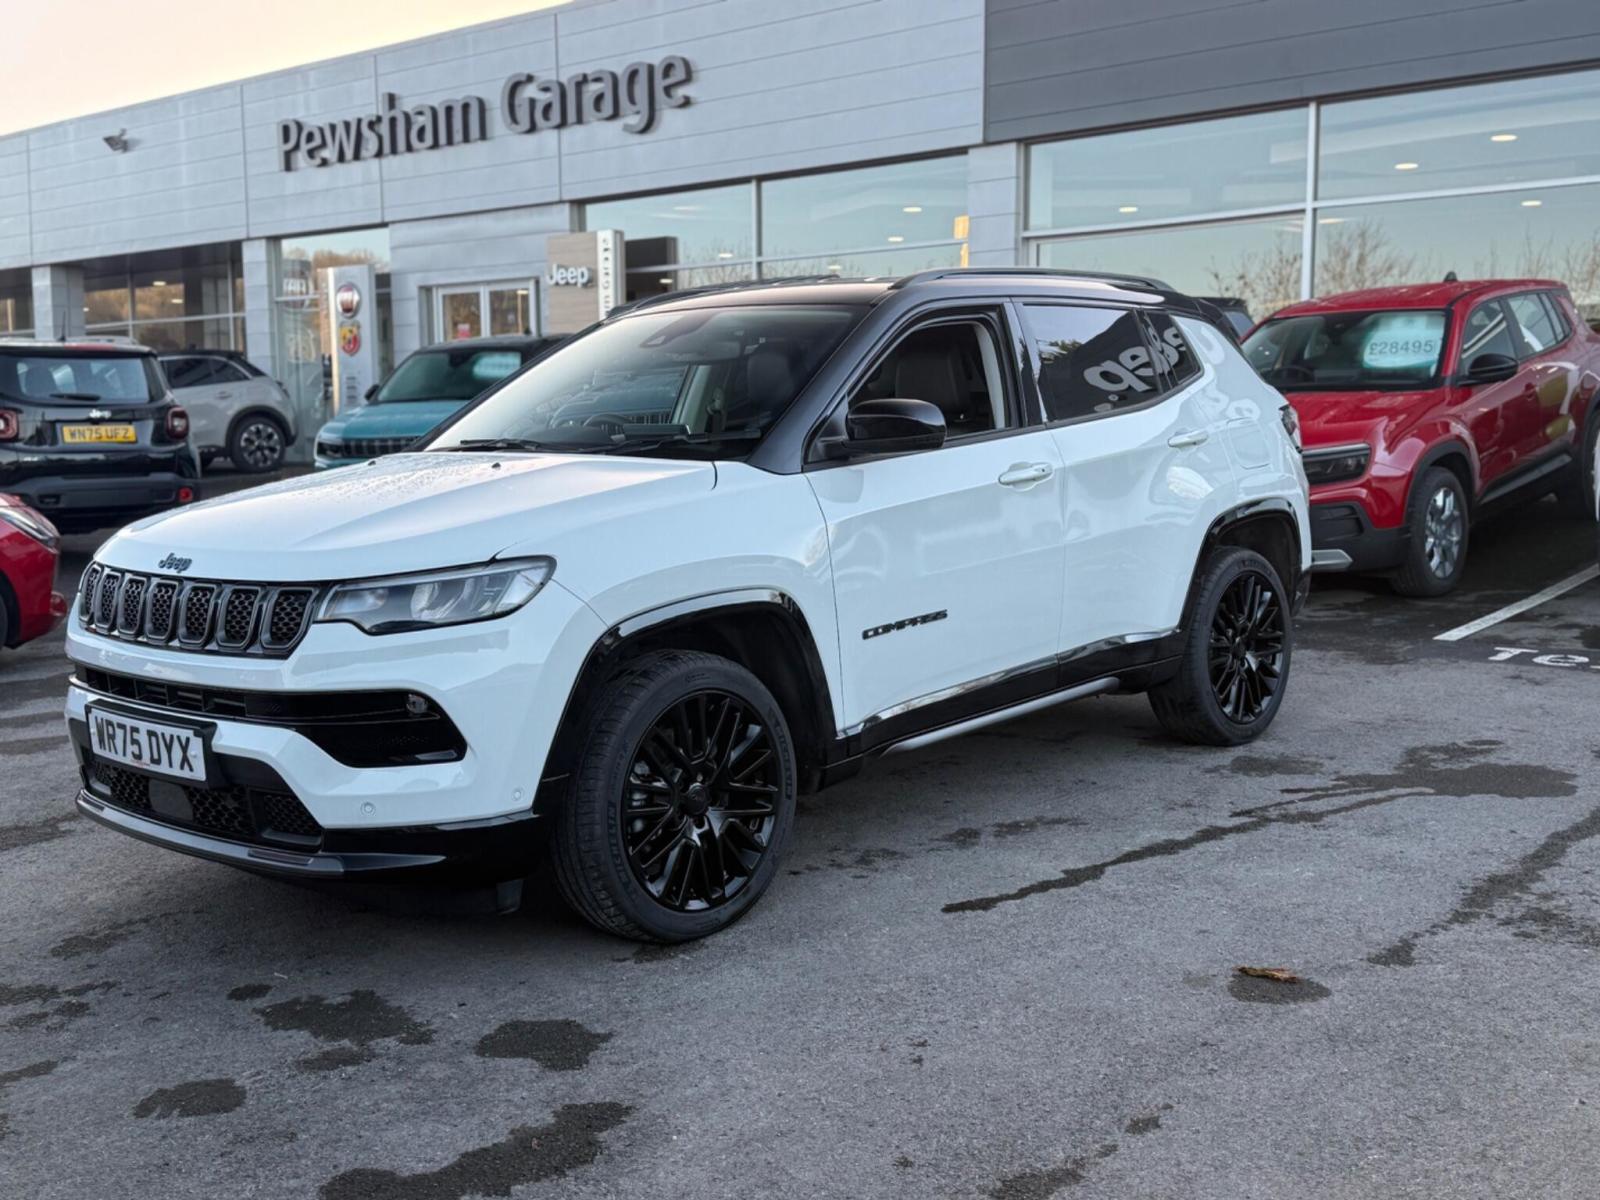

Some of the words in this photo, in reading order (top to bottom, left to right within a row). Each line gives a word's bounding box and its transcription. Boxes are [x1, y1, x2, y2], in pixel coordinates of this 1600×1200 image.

[276, 91, 491, 172] Pewsham
[501, 55, 693, 135] Garage
[548, 263, 592, 289] Jeep
[1369, 340, 1434, 356] £28495
[68, 427, 103, 440] WN75
[105, 426, 131, 440] UFZ
[158, 552, 193, 574] Jeep
[862, 609, 948, 640] COMPASS
[1487, 646, 1600, 669] Te
[94, 715, 143, 761] WR75
[146, 729, 195, 773] DYX
